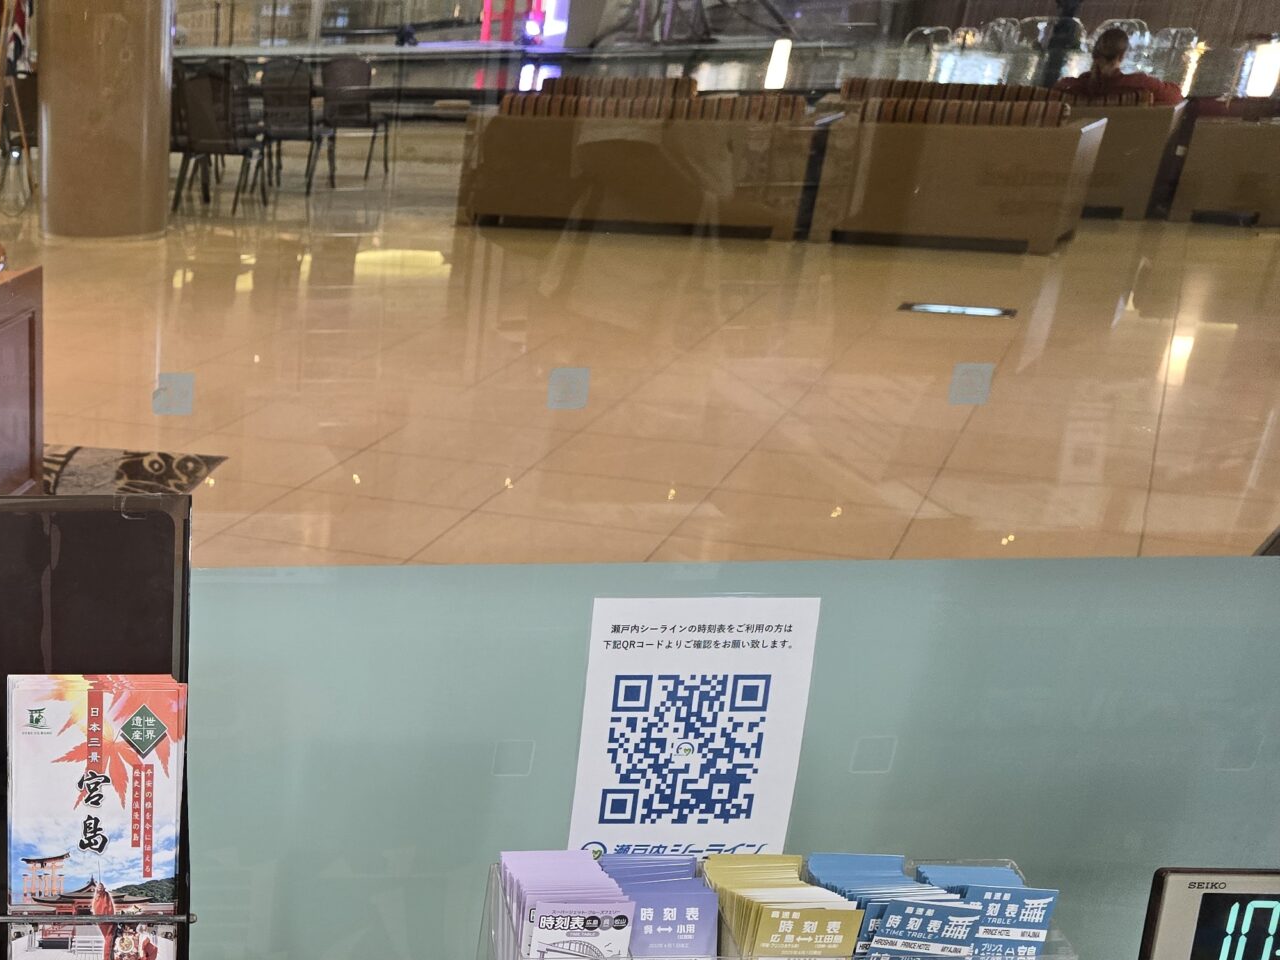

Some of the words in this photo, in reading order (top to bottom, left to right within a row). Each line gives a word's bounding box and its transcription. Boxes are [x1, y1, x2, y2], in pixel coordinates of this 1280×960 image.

[610, 624, 793, 634] 瀬戸内シーラインの時刻表をご利用の方は
[603, 639, 793, 650] 下記QRコードよりご確認をお願い致します。
[87, 708, 101, 763] 日本三景
[77, 771, 111, 853] 宮島
[1188, 882, 1227, 890] SEIKO
[640, 907, 700, 921] 時刻表
[985, 903, 1019, 917] 刻表
[538, 916, 586, 931] 時刻表
[676, 924, 696, 934] 小用
[778, 920, 842, 934] 時刻表
[885, 914, 943, 933] 時刻表
[885, 928, 903, 937] TIME
[770, 934, 795, 943] 広島
[814, 935, 844, 944] 江田島
[917, 941, 931, 951] HOTEL
[981, 943, 1003, 953] プリンス
